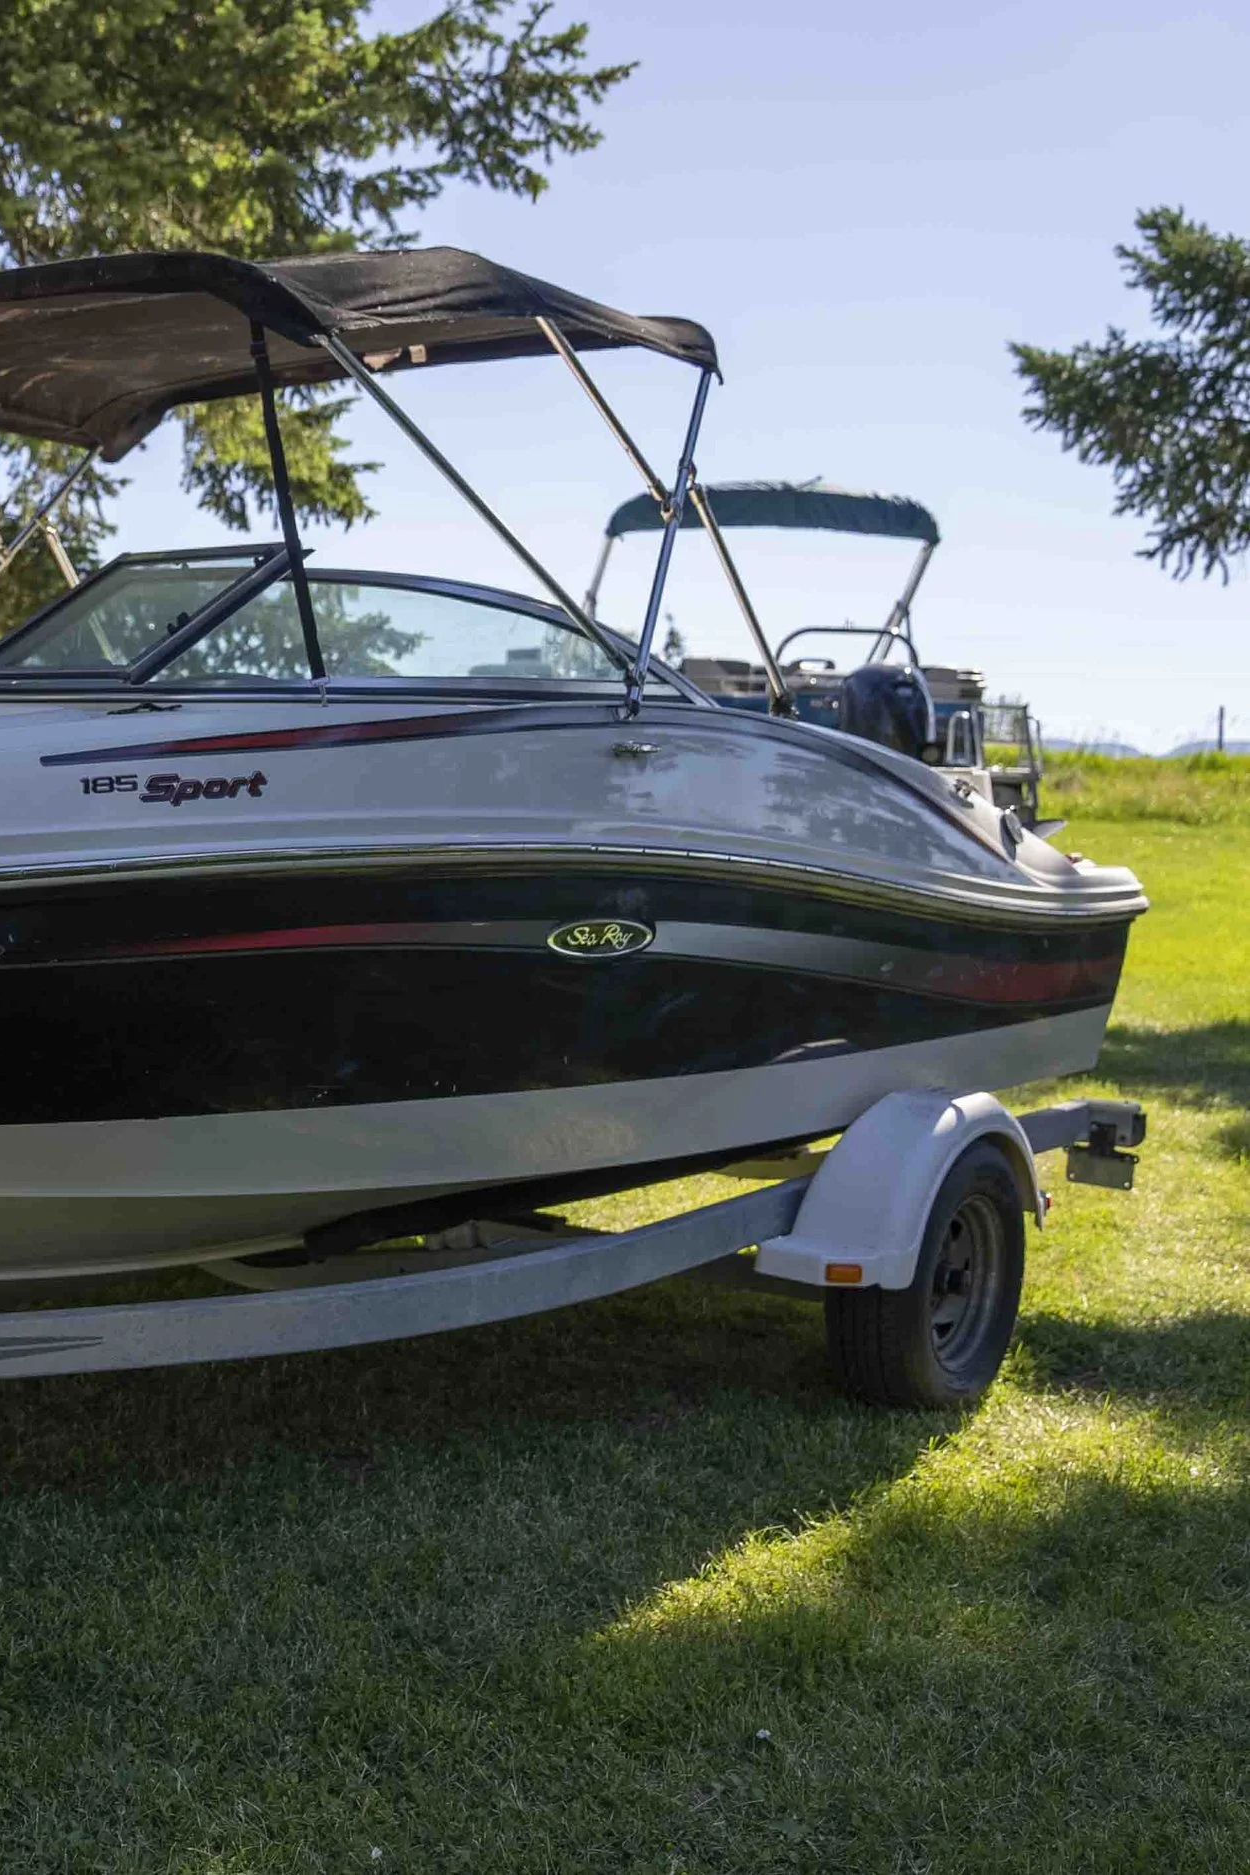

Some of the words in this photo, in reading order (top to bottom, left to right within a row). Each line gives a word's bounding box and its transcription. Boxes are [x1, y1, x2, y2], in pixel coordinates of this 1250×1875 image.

[80, 774, 138, 795] 185
[139, 770, 268, 807] Sport
[567, 926, 598, 946] Sea
[600, 923, 635, 950] Ray
